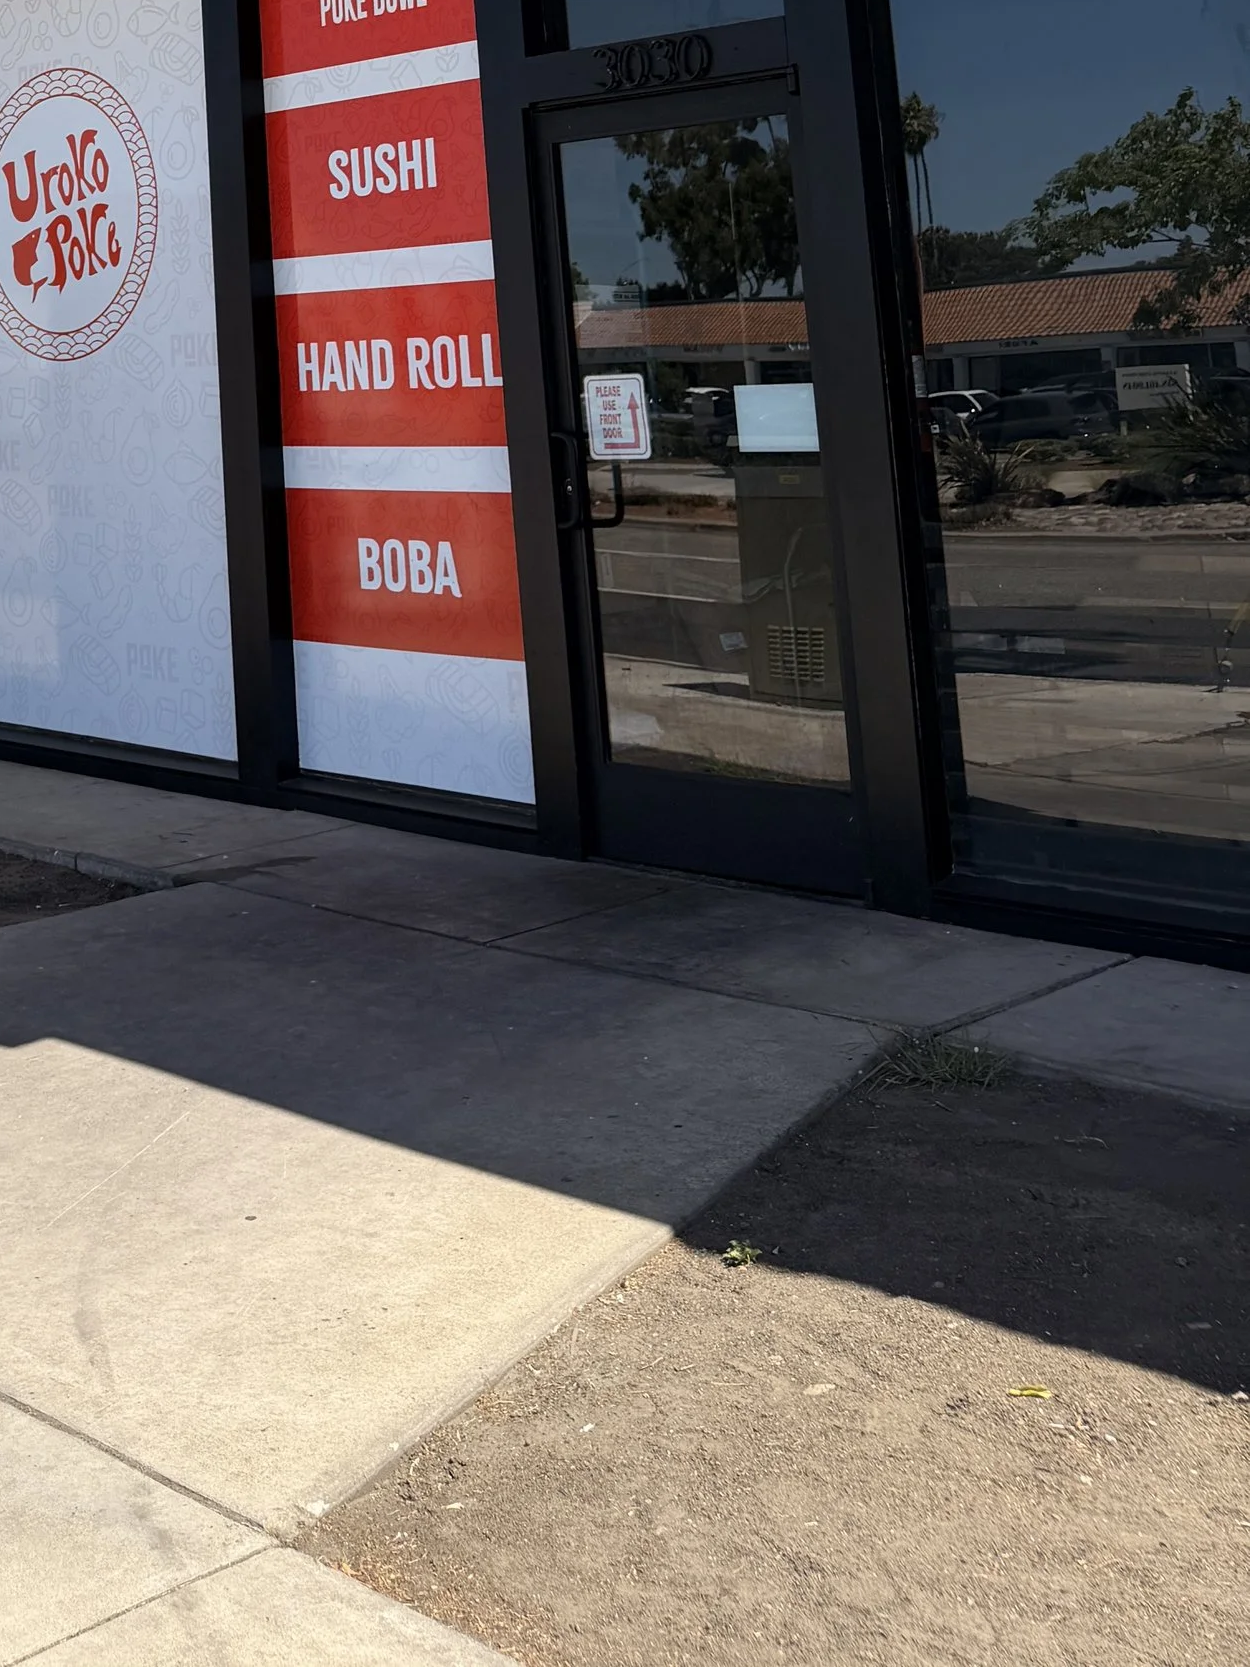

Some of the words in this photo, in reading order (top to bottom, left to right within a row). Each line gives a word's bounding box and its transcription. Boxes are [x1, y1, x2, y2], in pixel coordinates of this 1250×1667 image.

[592, 34, 713, 90] 3030
[328, 137, 437, 200] SUSHI
[297, 338, 395, 393] HAND
[406, 333, 503, 390] ROLL
[595, 385, 621, 397] PLEASE
[602, 400, 617, 411] USE
[599, 413, 622, 425] FRONT
[602, 427, 623, 438] DOOR
[357, 537, 463, 599] BOBA
